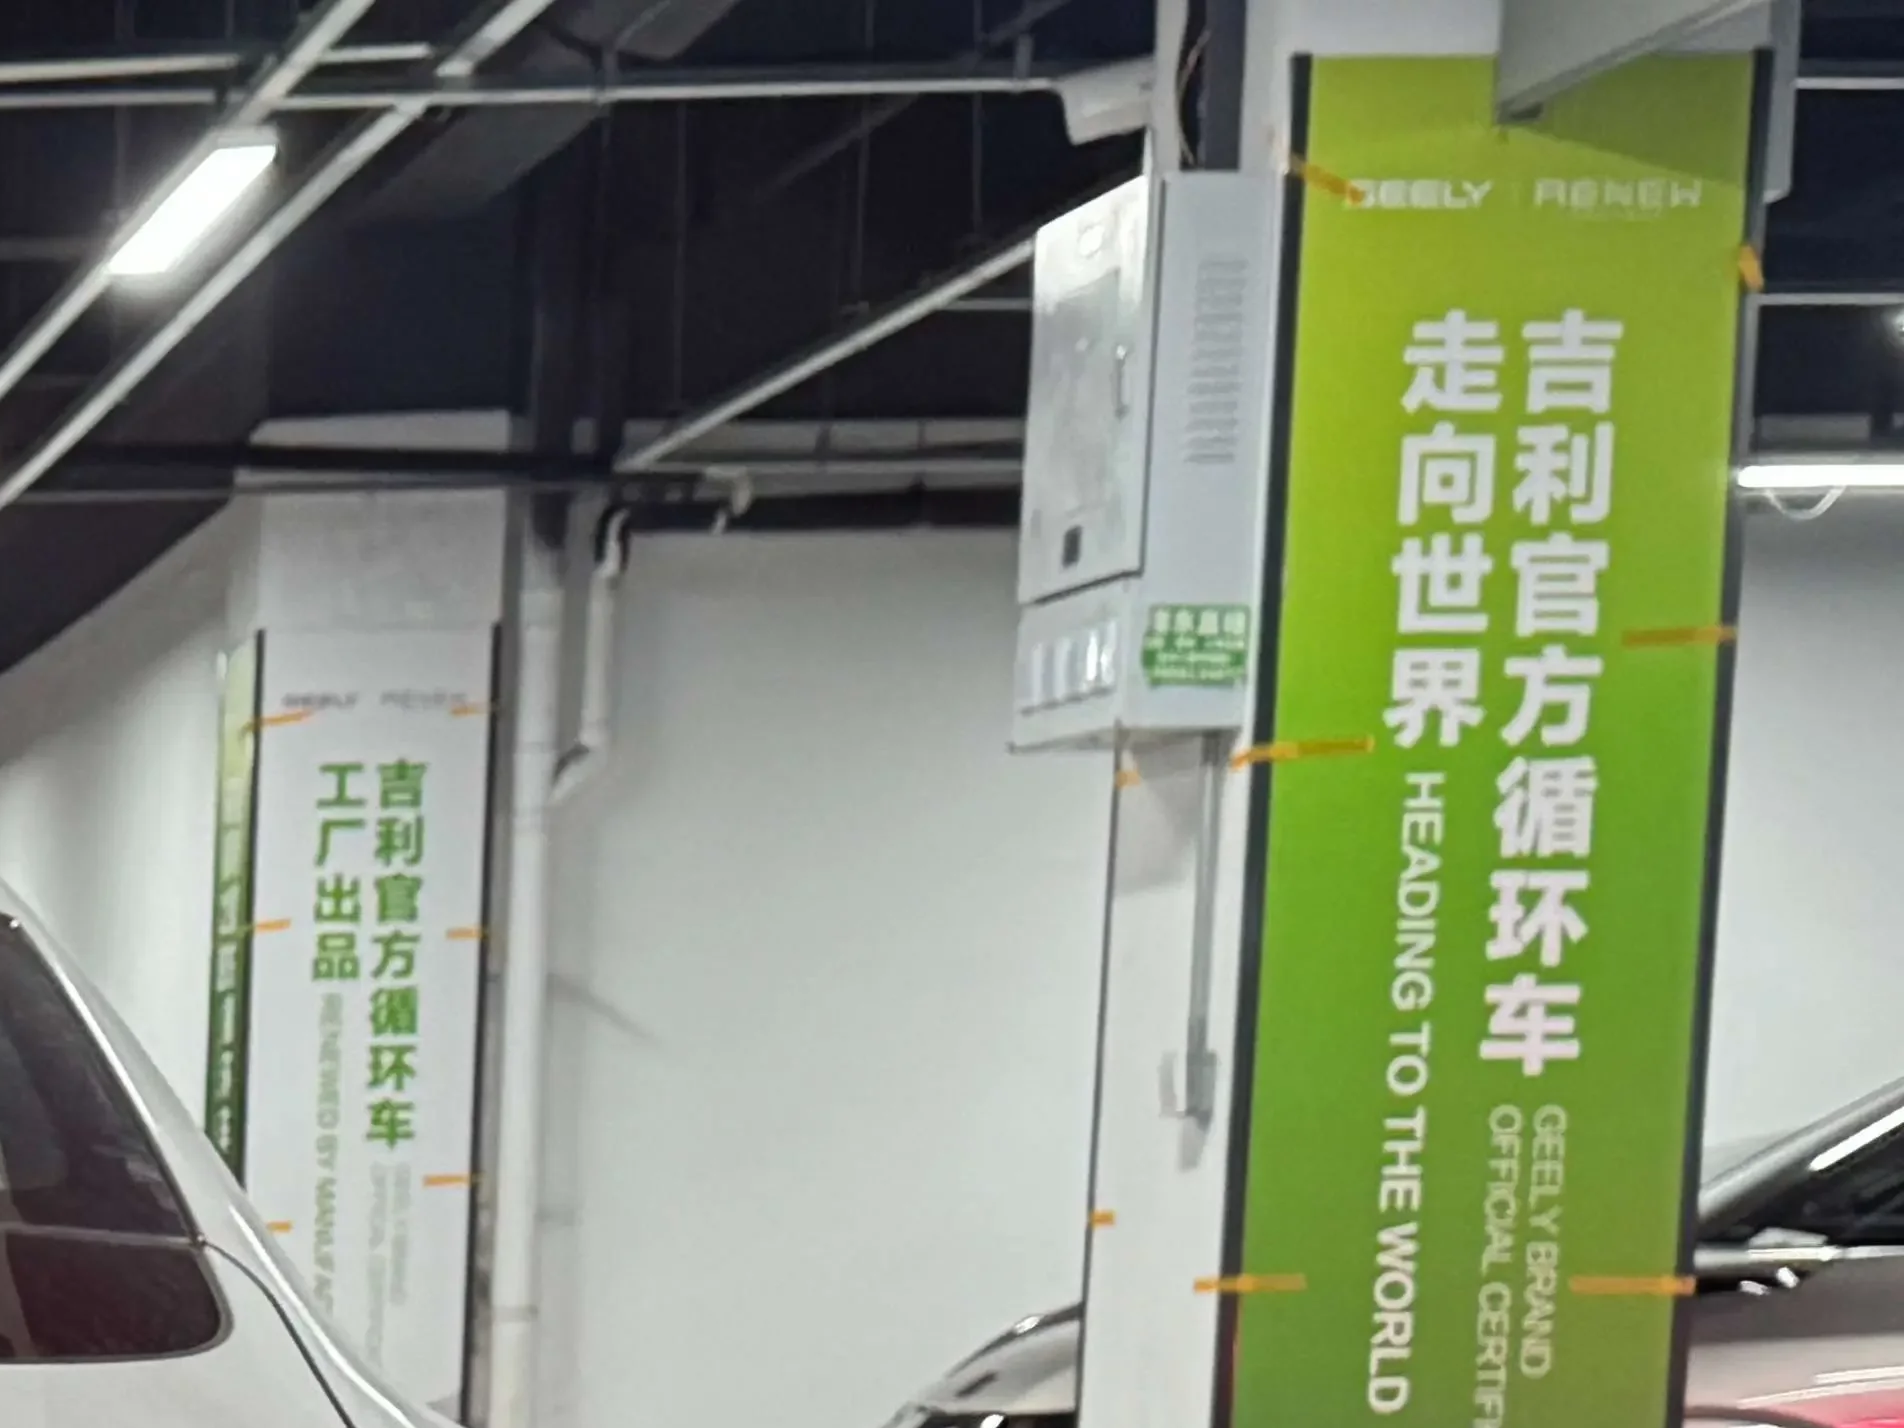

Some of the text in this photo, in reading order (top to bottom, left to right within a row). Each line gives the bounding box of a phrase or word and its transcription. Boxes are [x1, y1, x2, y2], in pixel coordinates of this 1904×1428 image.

[1383, 309, 1505, 748] 走向世界
[1478, 309, 1623, 1077] 吉利官方循环车
[310, 763, 367, 982] 工厂出品
[365, 759, 426, 1149] 吉利官方循环车
[1367, 772, 1445, 1414] HEADING TO THE WORLD
[1480, 1104, 1523, 1273] OFFICIAL
[1519, 1104, 1568, 1379] GEELY BRAND
